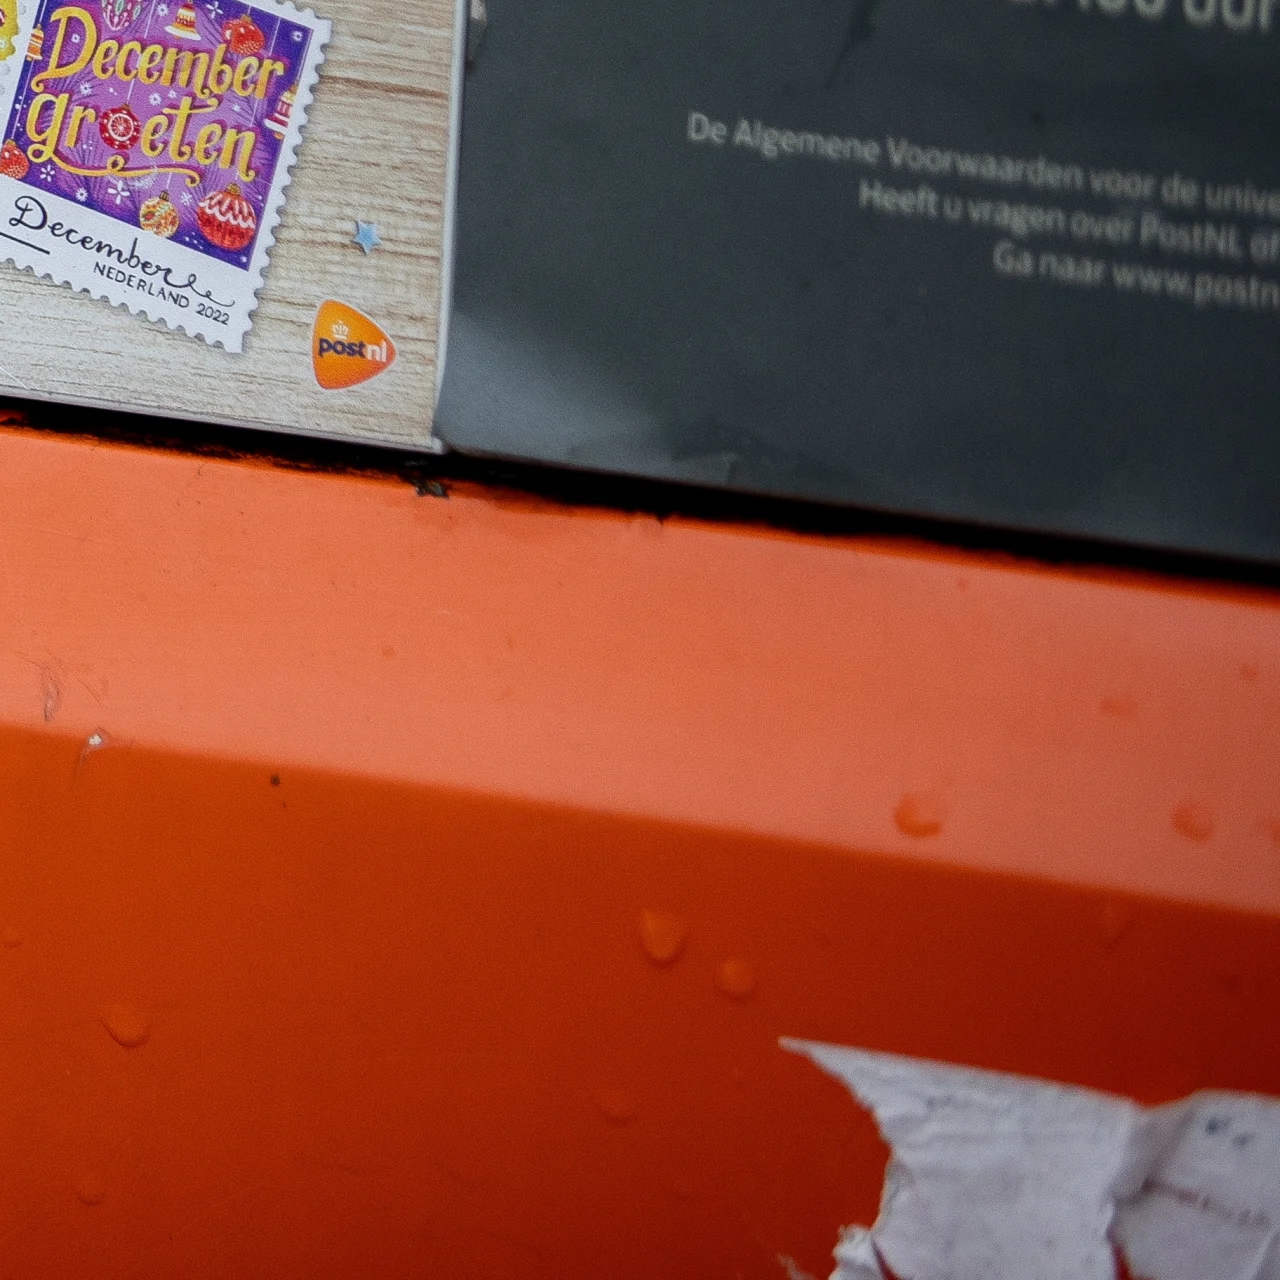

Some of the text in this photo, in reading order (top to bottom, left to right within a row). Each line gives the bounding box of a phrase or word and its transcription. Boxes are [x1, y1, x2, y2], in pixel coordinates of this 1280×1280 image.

[31, 6, 288, 109] December
[687, 111, 728, 146] De
[733, 117, 881, 164] Algemene
[885, 136, 1084, 191] Voorwaarden
[1088, 165, 1155, 201] voor
[1161, 170, 1199, 208] de
[858, 179, 939, 218] Heeft
[943, 195, 961, 221] u
[965, 199, 1066, 237] vragen
[1070, 207, 1136, 243] over
[9, 195, 235, 308] December
[992, 240, 1034, 276] Ga
[1038, 248, 1106, 286] naar
[93, 260, 230, 326] NEDERLAND 2022
[318, 337, 387, 362] postnl
